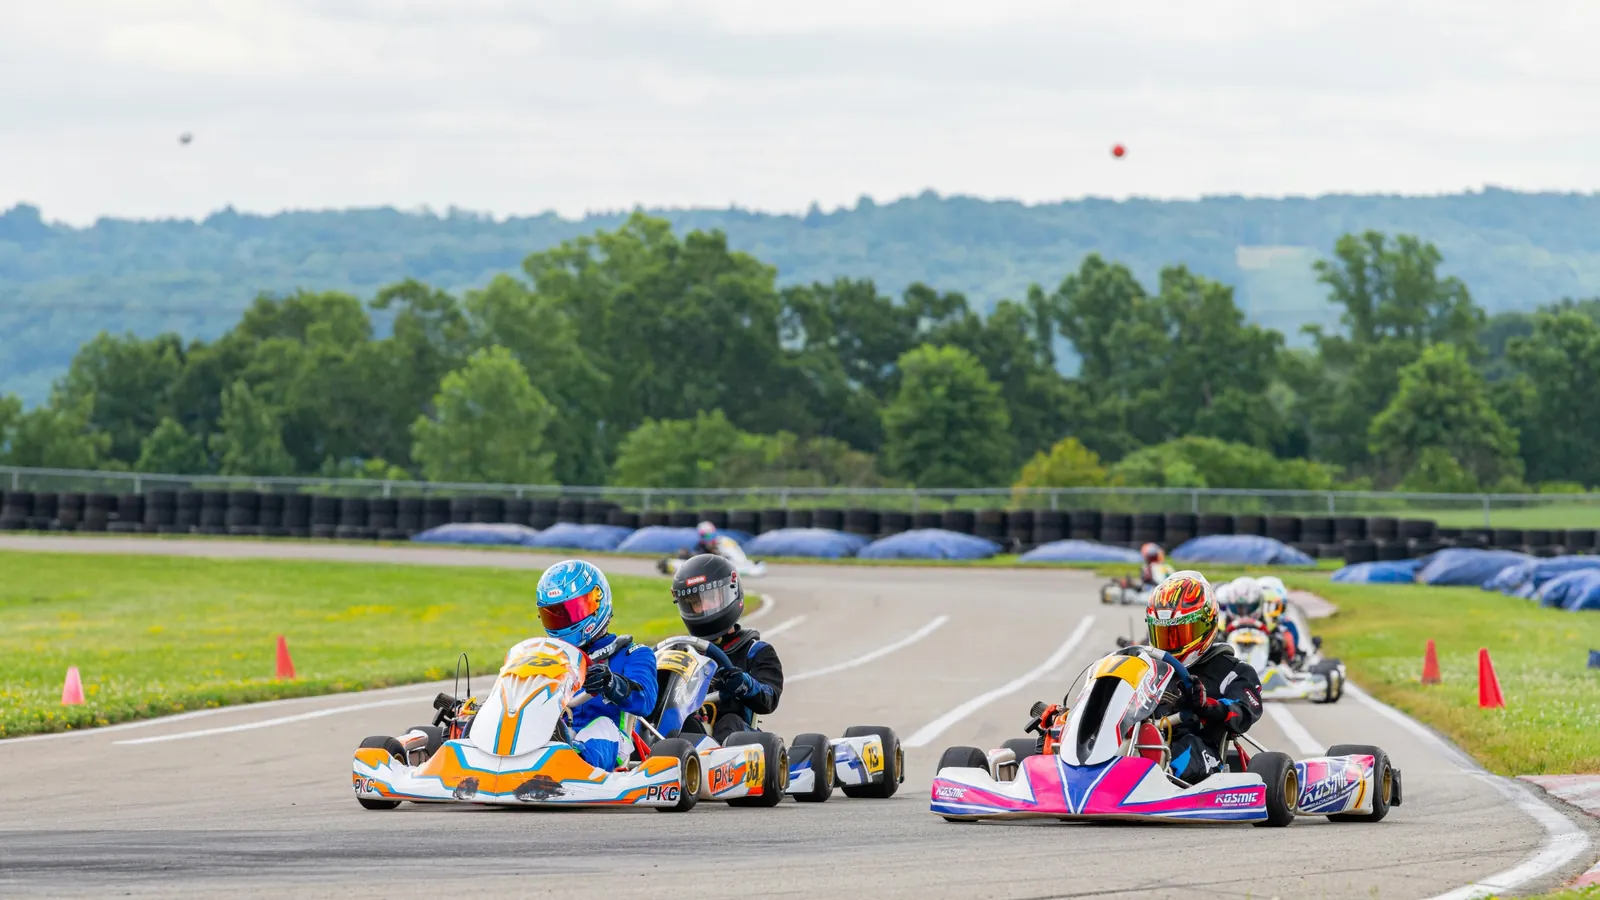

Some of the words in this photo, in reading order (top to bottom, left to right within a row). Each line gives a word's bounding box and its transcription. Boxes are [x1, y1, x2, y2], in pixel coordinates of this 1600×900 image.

[713, 761, 735, 790] PKC
[355, 778, 375, 793] PKC
[646, 785, 679, 801] PKC
[1301, 768, 1349, 806] KOSMIC
[1215, 793, 1259, 804] KOSMIC
